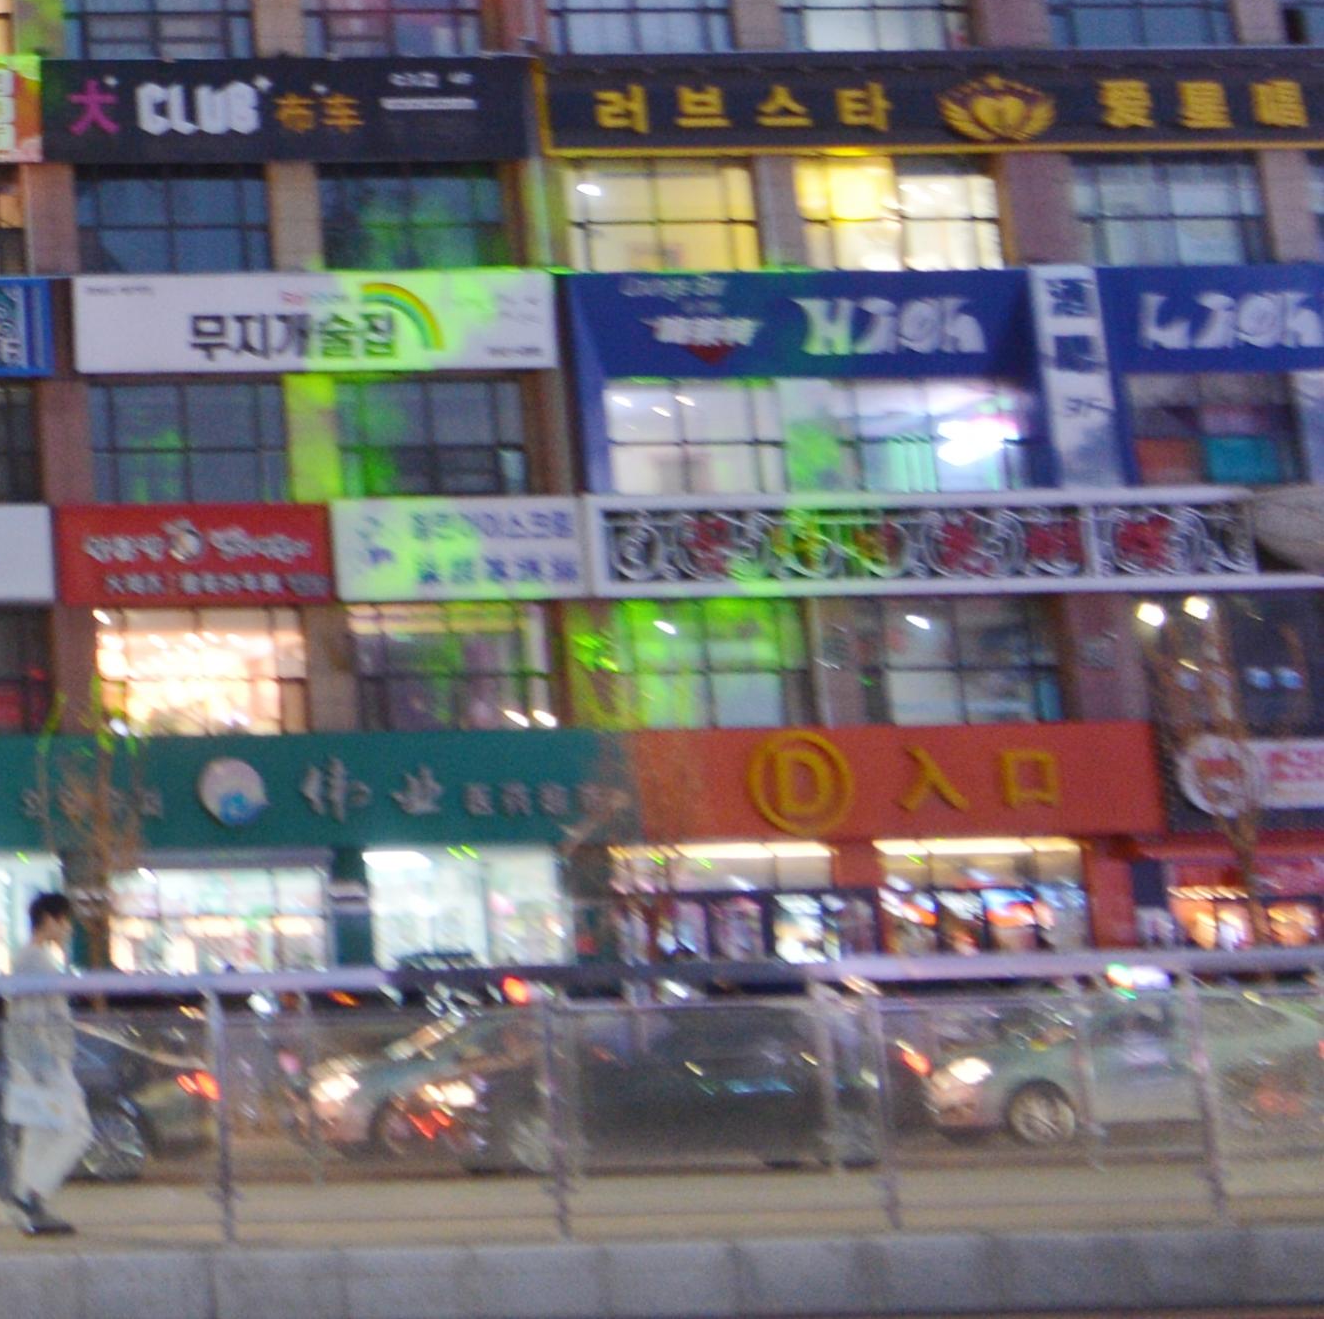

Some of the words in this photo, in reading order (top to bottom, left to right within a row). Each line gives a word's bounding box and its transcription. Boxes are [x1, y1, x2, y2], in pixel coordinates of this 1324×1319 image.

[66, 79, 120, 136] 大
[135, 80, 262, 136] CLUB
[899, 746, 1062, 812] 入口
